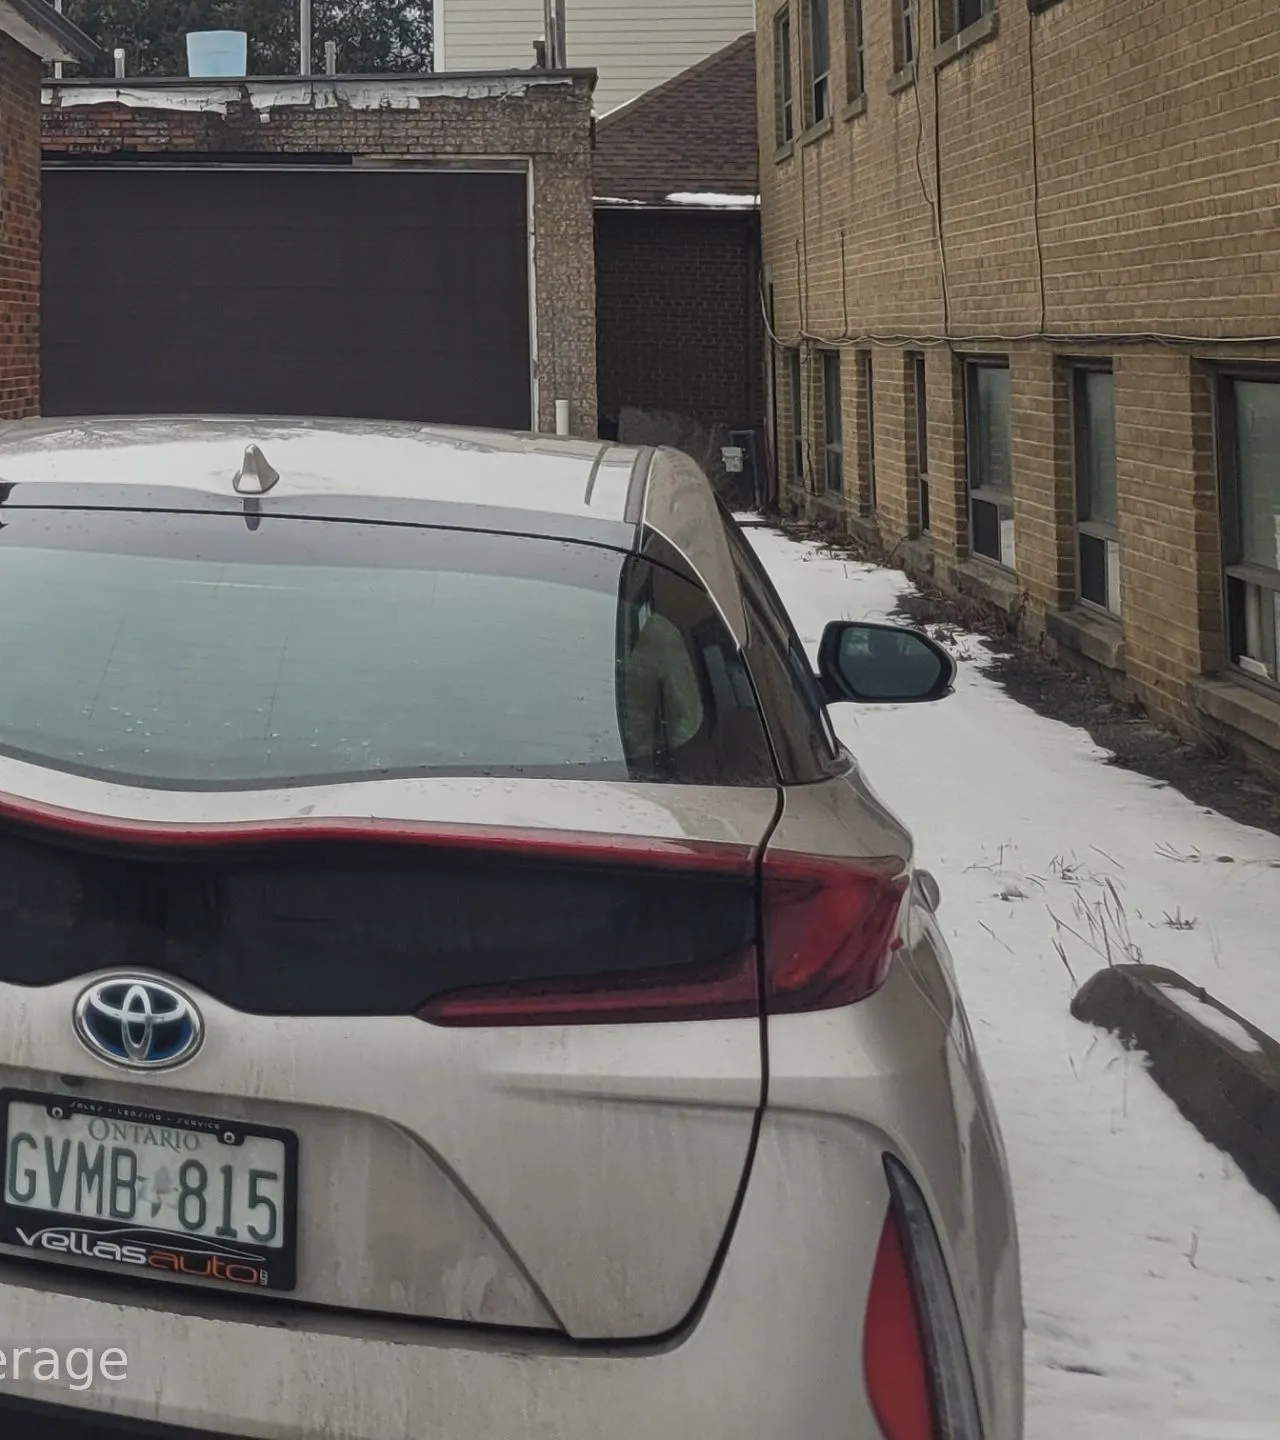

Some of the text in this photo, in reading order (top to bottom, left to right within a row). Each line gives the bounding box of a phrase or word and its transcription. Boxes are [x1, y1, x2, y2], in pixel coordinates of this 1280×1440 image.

[88, 1117, 201, 1154] ONTARIO
[8, 1131, 279, 1243] GVMB 815
